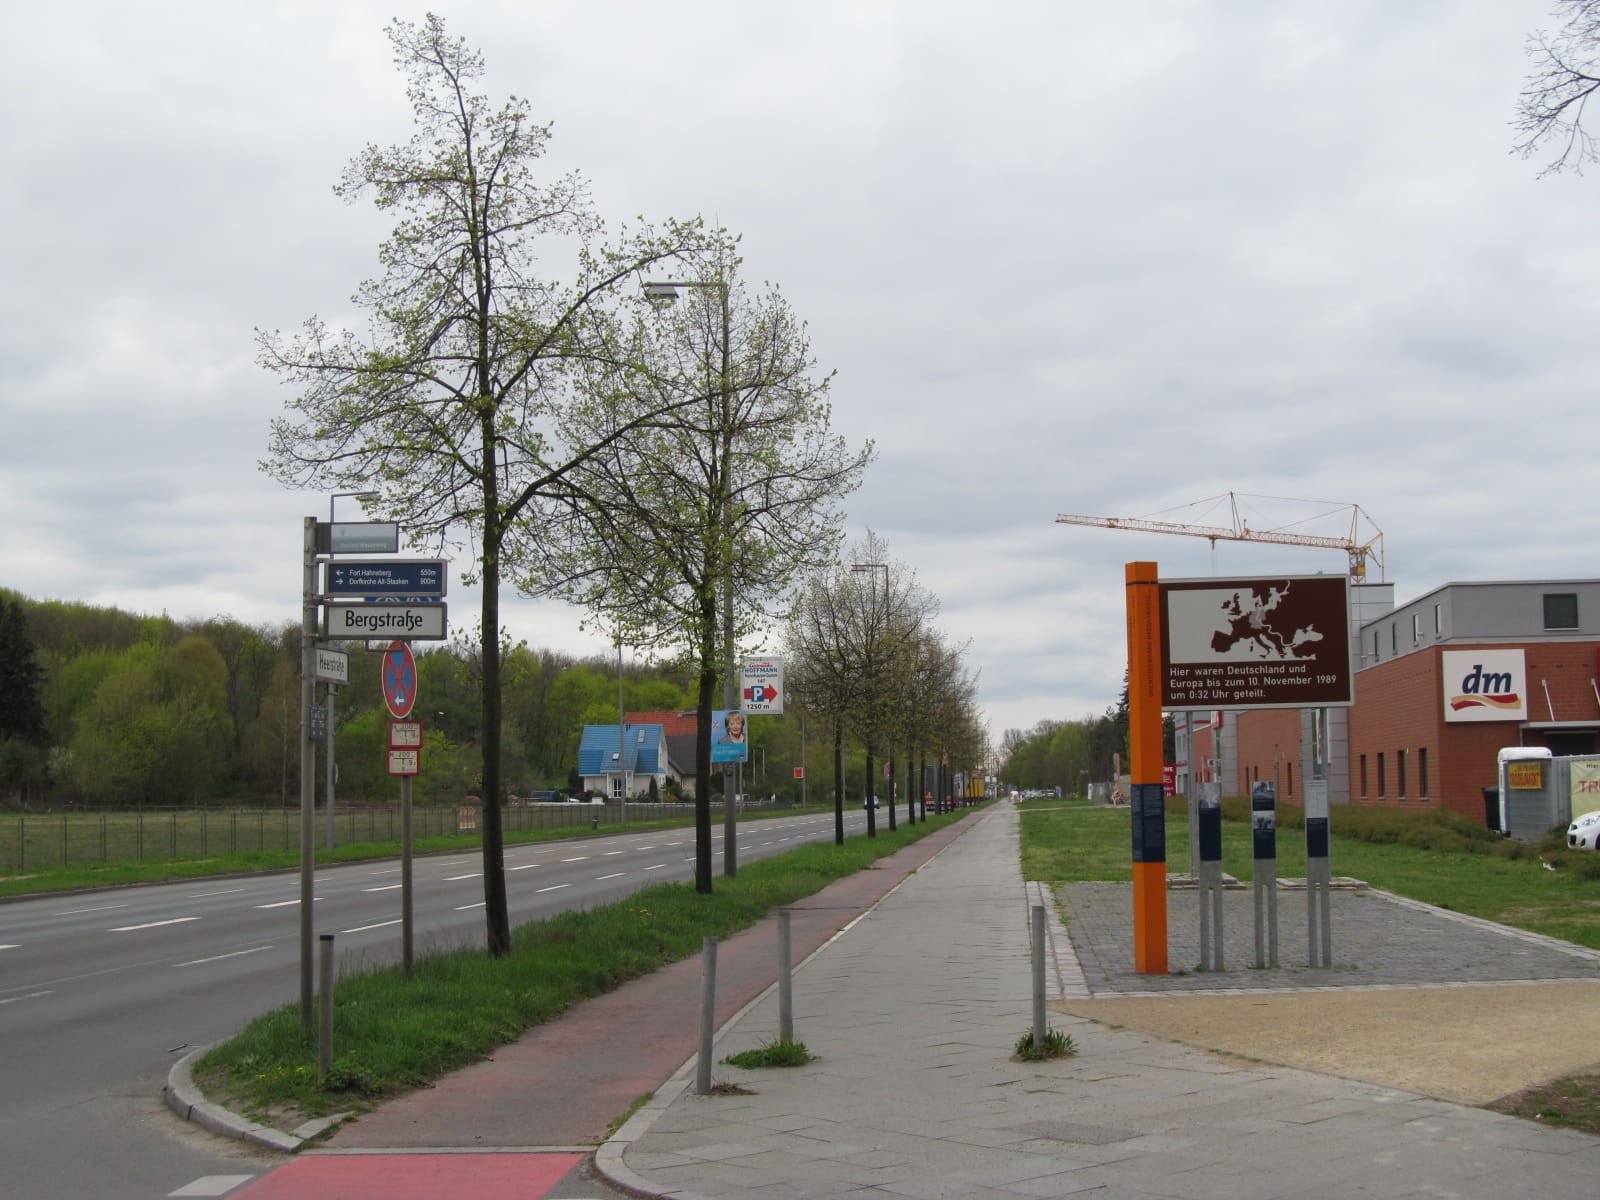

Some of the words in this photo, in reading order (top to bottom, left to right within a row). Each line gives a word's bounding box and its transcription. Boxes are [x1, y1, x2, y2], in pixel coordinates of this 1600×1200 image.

[346, 610, 423, 631] Bergstraße
[1170, 667, 1190, 676] Hier
[1195, 668, 1224, 676] waren
[1228, 665, 1285, 674] Deutschland
[1289, 664, 1306, 673] und
[1170, 680, 1203, 689] Europa
[1207, 678, 1221, 687] bis
[1264, 676, 1312, 685] November
[1317, 675, 1337, 684] 1989
[1462, 664, 1512, 694] dm
[754, 688, 763, 700] P
[1189, 690, 1208, 698] 0:32
[1212, 690, 1230, 698] Uhr
[1234, 689, 1266, 699] geteilt.
[1578, 780, 1600, 792] TR
